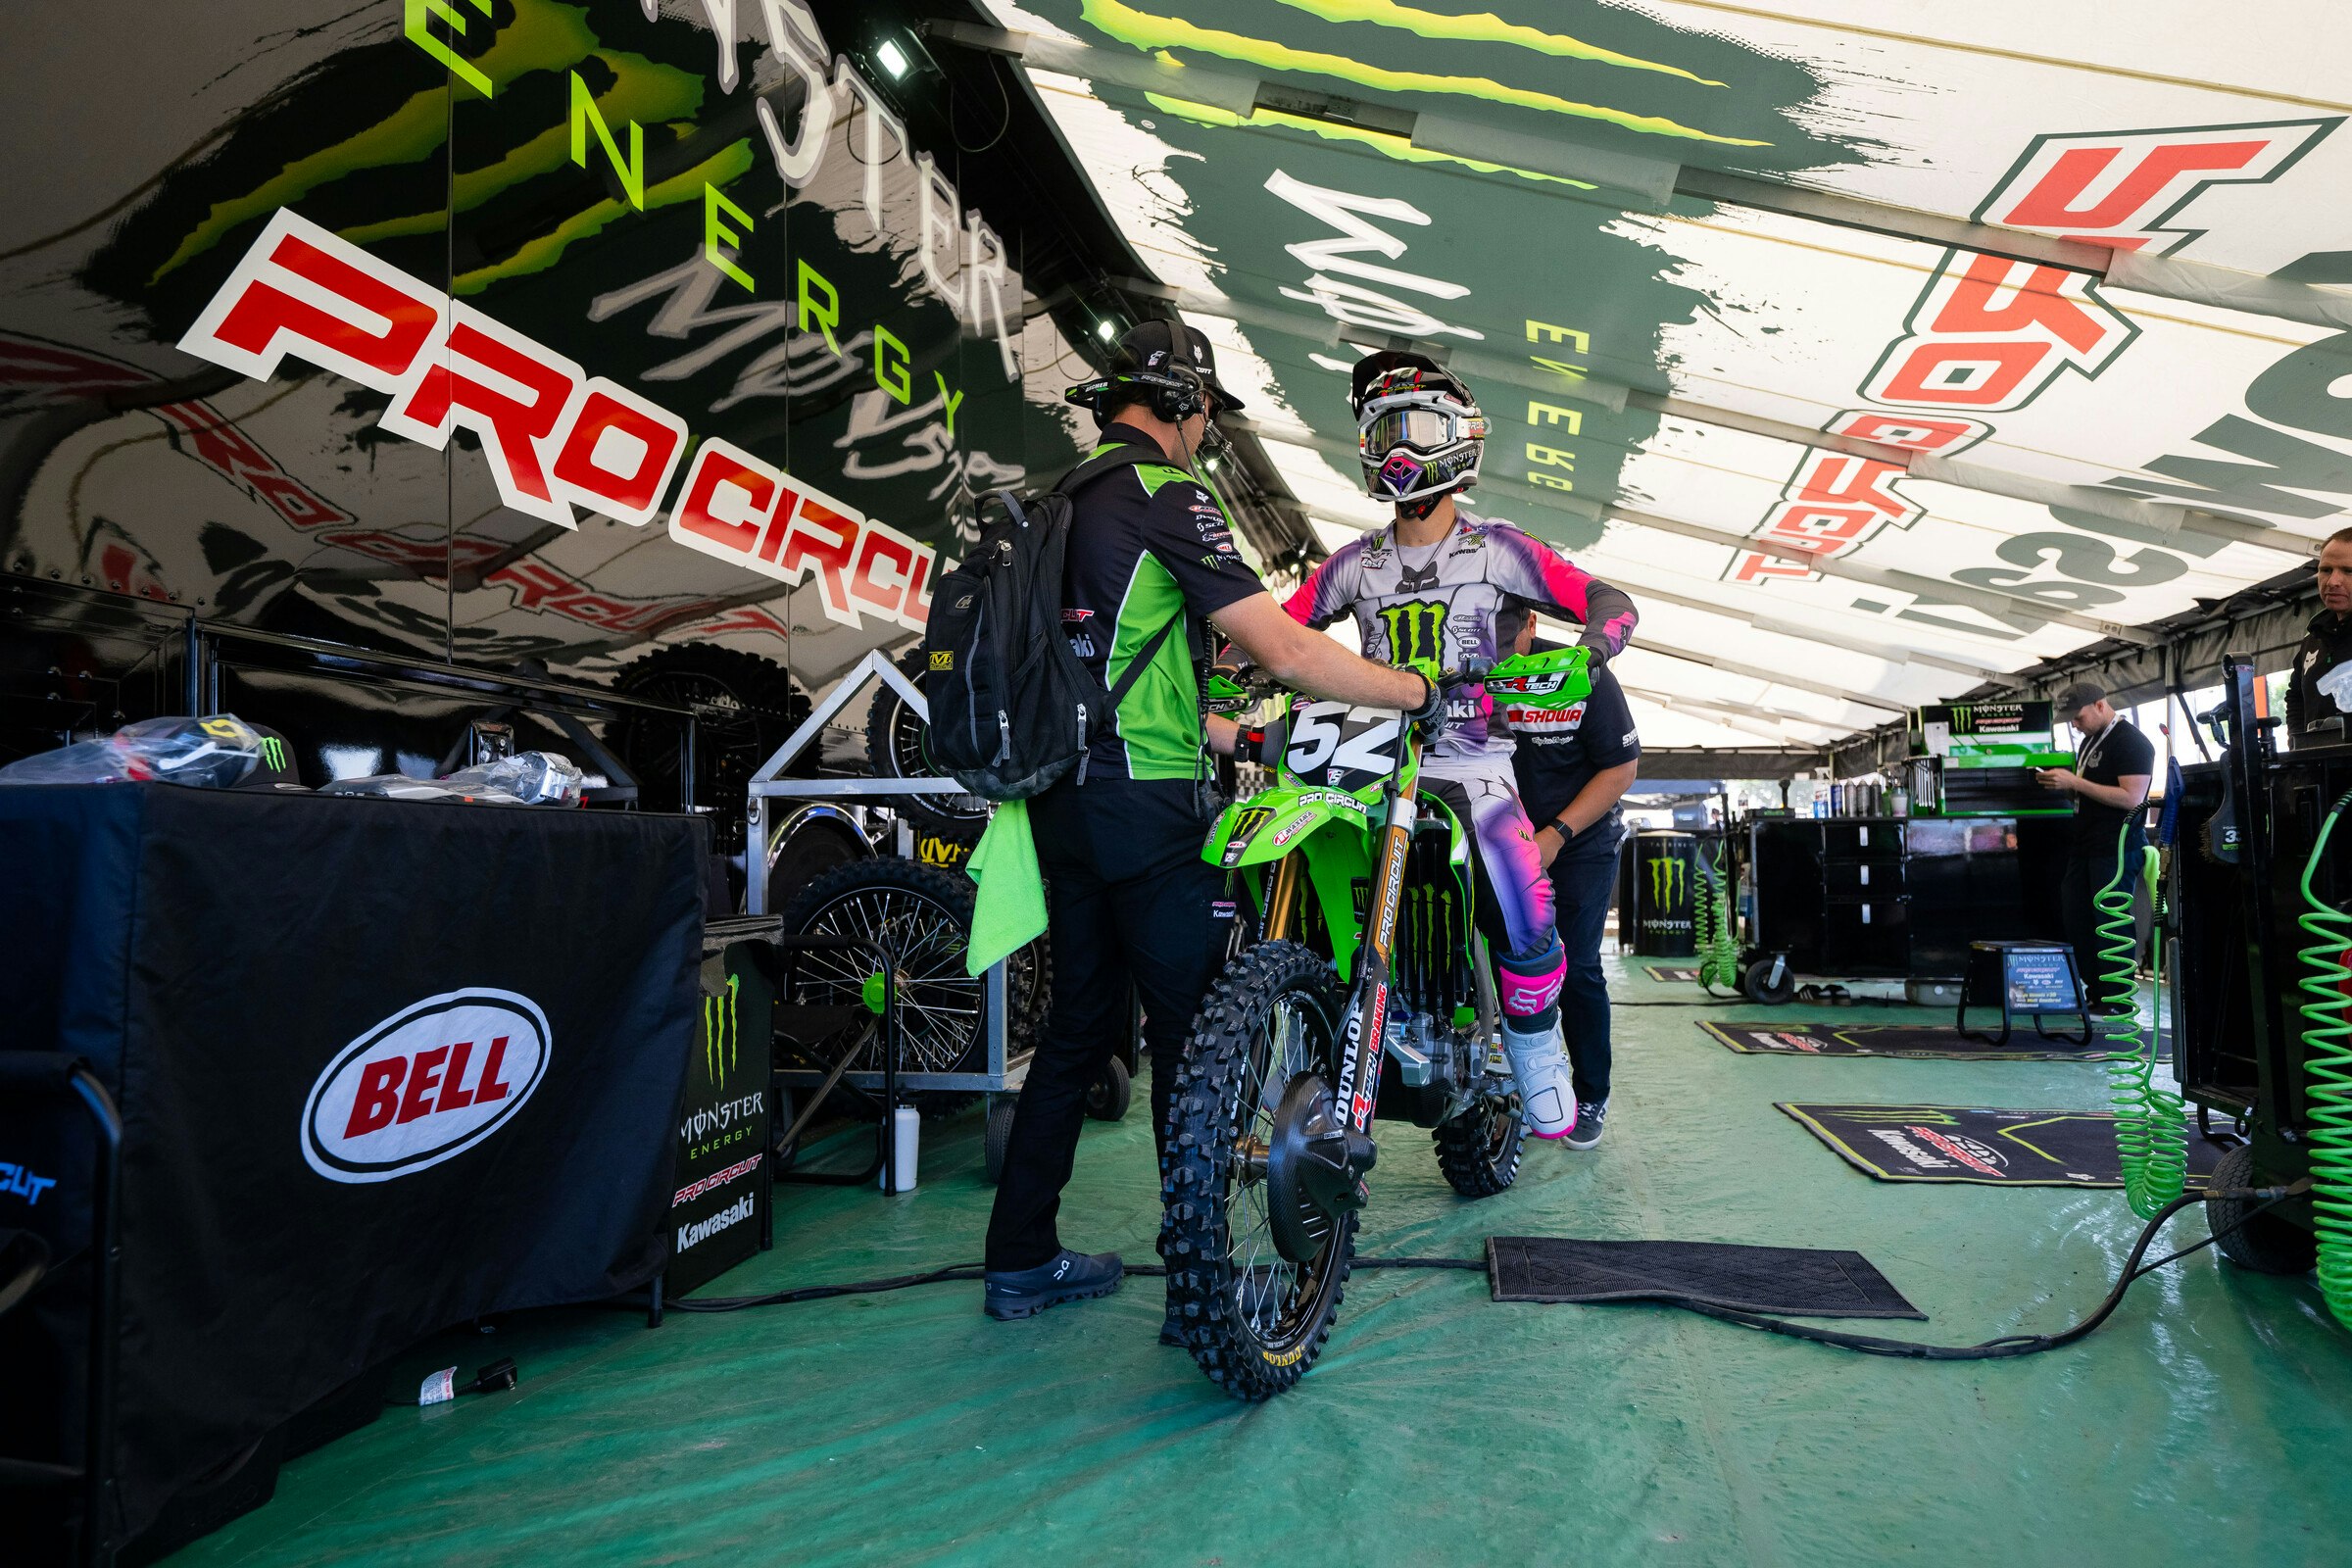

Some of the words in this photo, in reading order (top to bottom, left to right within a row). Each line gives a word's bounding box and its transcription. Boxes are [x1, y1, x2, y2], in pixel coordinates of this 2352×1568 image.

[404, 0, 963, 438] ENERGY
[193, 218, 684, 522] PRO
[672, 441, 941, 623] CIRCU
[1523, 710, 1583, 723] SHOWA
[1973, 704, 2024, 713] MONSTER
[1979, 724, 2020, 733] Kawasaki
[1287, 701, 1409, 775] 52
[1384, 837, 1404, 906] CIRCUIT
[1379, 906, 1395, 948] PRO
[1643, 918, 1692, 930] MONSTER
[1369, 982, 1388, 1054] BRAKING
[343, 1036, 510, 1140] BELL
[681, 1092, 763, 1144] MONSTER
[690, 1126, 753, 1160] ENERGY
[672, 1178, 707, 1207] PRO
[706, 1153, 762, 1192] CIRCUIT
[677, 1192, 755, 1254] Kawasaki
[1262, 1346, 1302, 1367] DUNLOP
